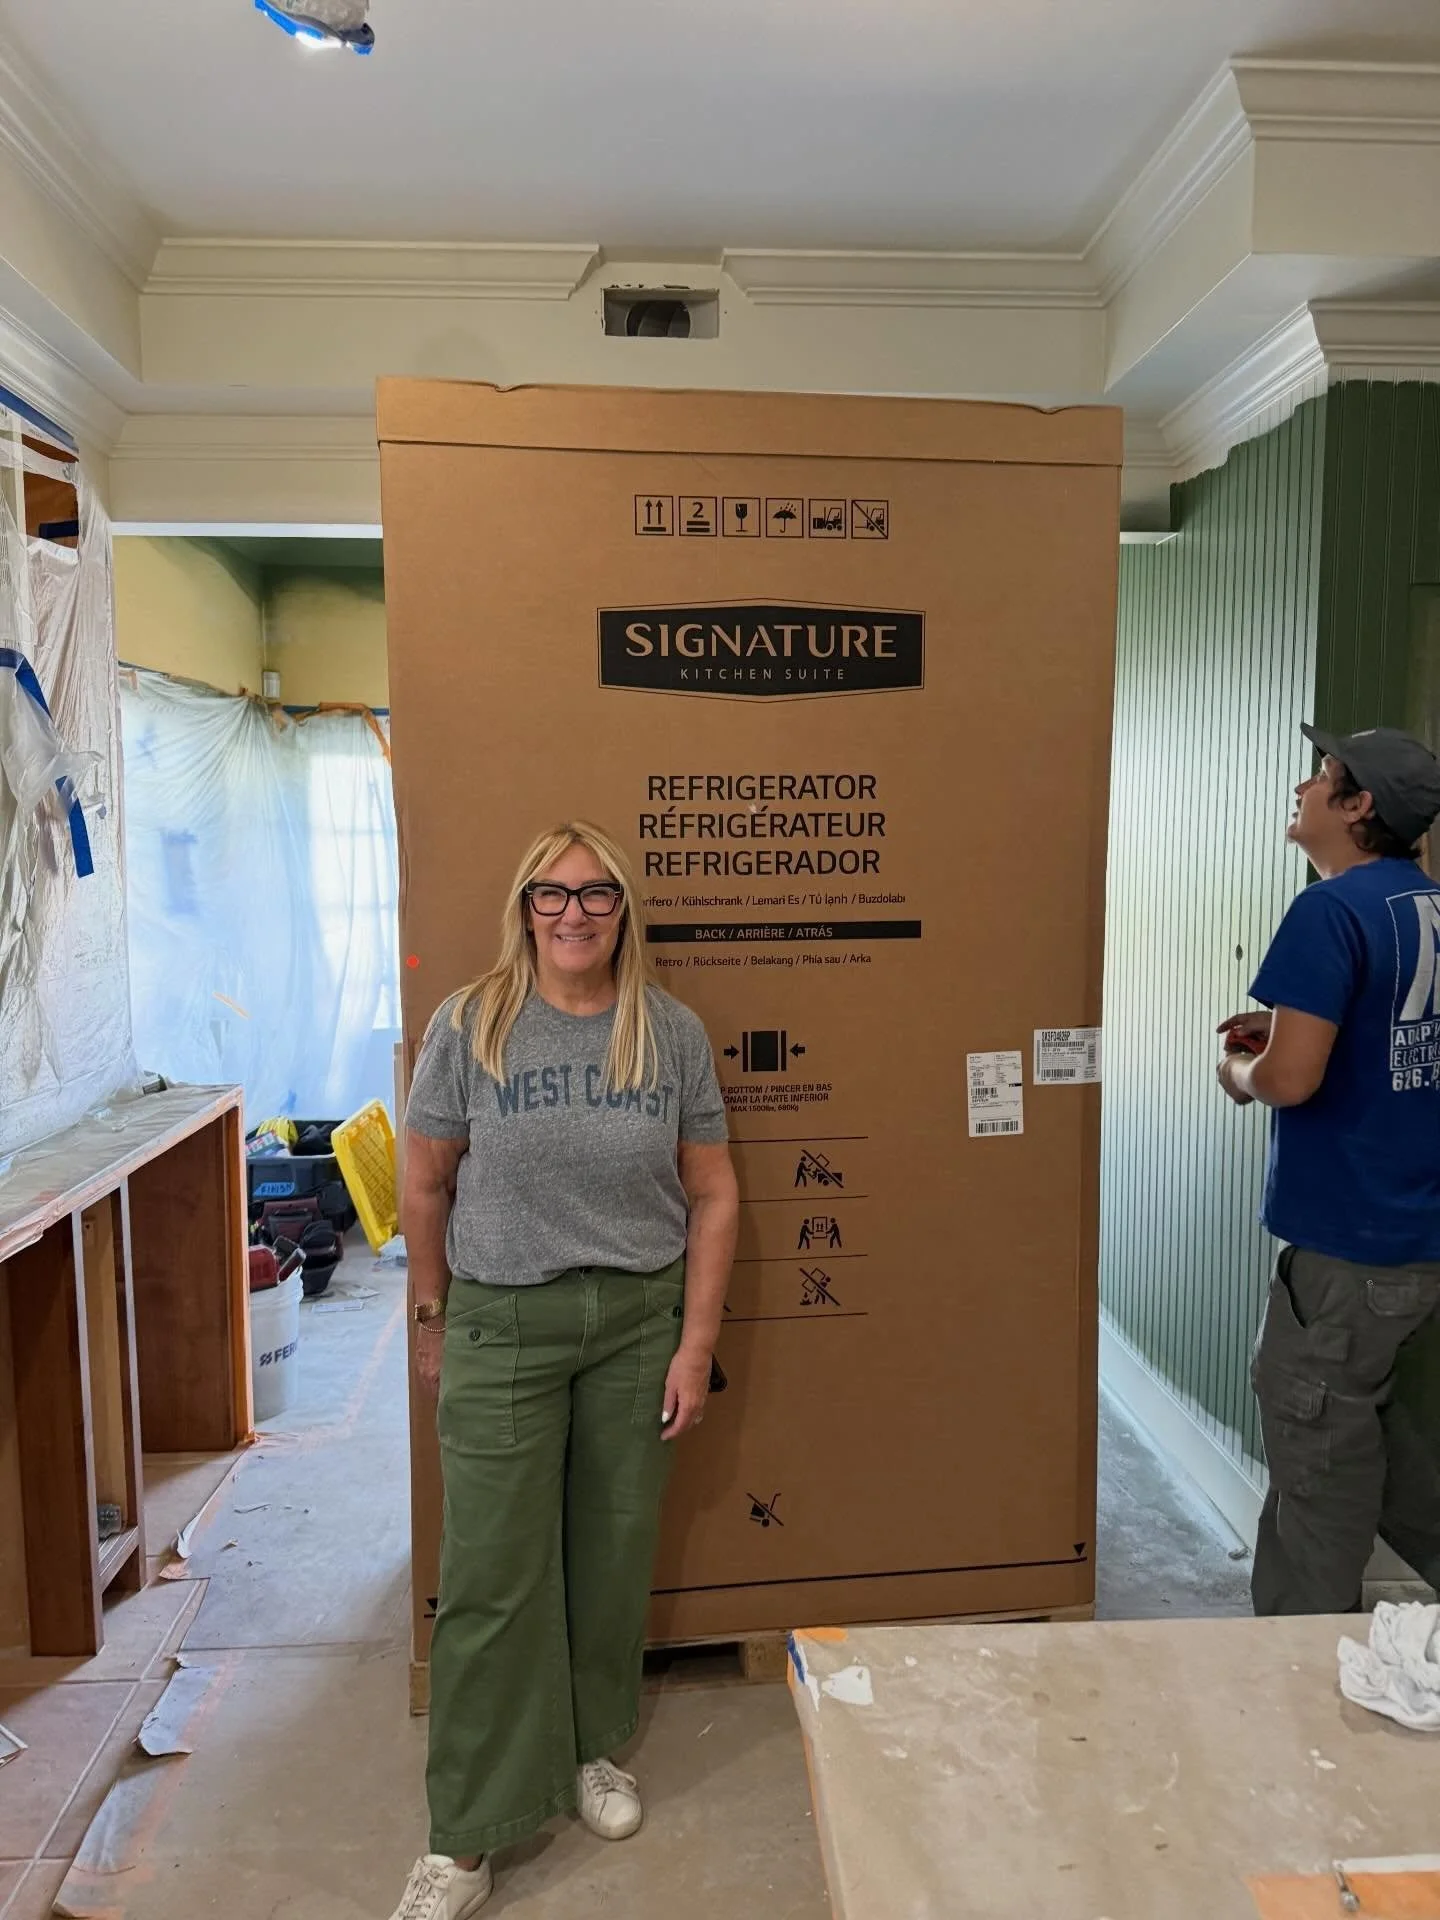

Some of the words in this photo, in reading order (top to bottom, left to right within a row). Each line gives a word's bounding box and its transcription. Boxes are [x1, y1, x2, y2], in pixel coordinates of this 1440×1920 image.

[691, 502, 704, 518] 2
[625, 623, 897, 658] SIGNATURE
[680, 668, 773, 680] KITCHEN
[785, 668, 845, 680] SUITE
[648, 774, 877, 801] REFRIGERATOR
[639, 805, 886, 839] RÉFRIGÉRATEUR
[645, 850, 881, 877] REFRIGERADOR
[681, 896, 743, 907] Kühlschrank
[752, 895, 785, 906] Lemari
[787, 894, 800, 905] Es
[695, 929, 726, 939] BACK
[736, 925, 785, 939] ARRIÈRE
[795, 925, 833, 937] ATRÁS
[655, 957, 683, 967] Retro
[693, 956, 741, 967] Rückseite
[750, 955, 793, 967] Belakang
[824, 956, 840, 964] sau
[849, 953, 872, 963] Arka
[494, 1064, 572, 1117] WEST
[727, 1085, 763, 1094] BOTTOM
[770, 1084, 801, 1093] PINCER
[803, 1084, 814, 1092] EN
[816, 1083, 832, 1091] BAS
[750, 1095, 760, 1103] LA
[762, 1094, 789, 1103] PARTE
[790, 1093, 829, 1102] INFERIOR
